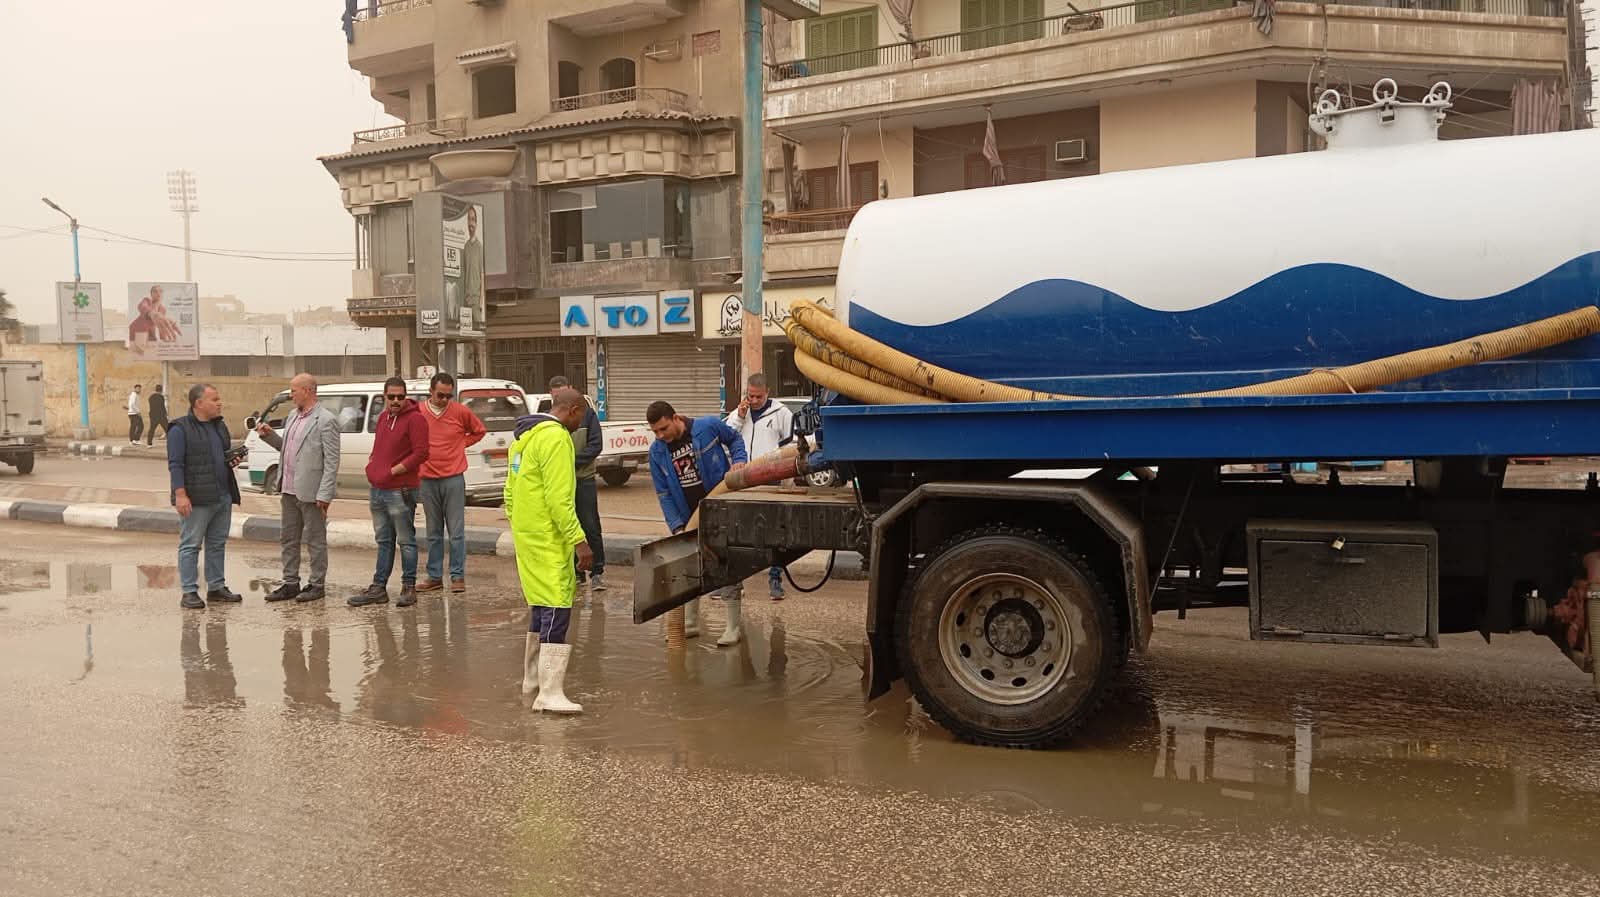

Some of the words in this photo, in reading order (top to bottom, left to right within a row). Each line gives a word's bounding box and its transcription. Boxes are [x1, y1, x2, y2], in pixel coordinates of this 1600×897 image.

[564, 305, 589, 328] A
[601, 305, 648, 328] TO
[664, 297, 690, 325] Z
[597, 366, 605, 389] TO
[720, 363, 726, 388] TO
[597, 401, 605, 412] Z
[720, 400, 726, 412] Z
